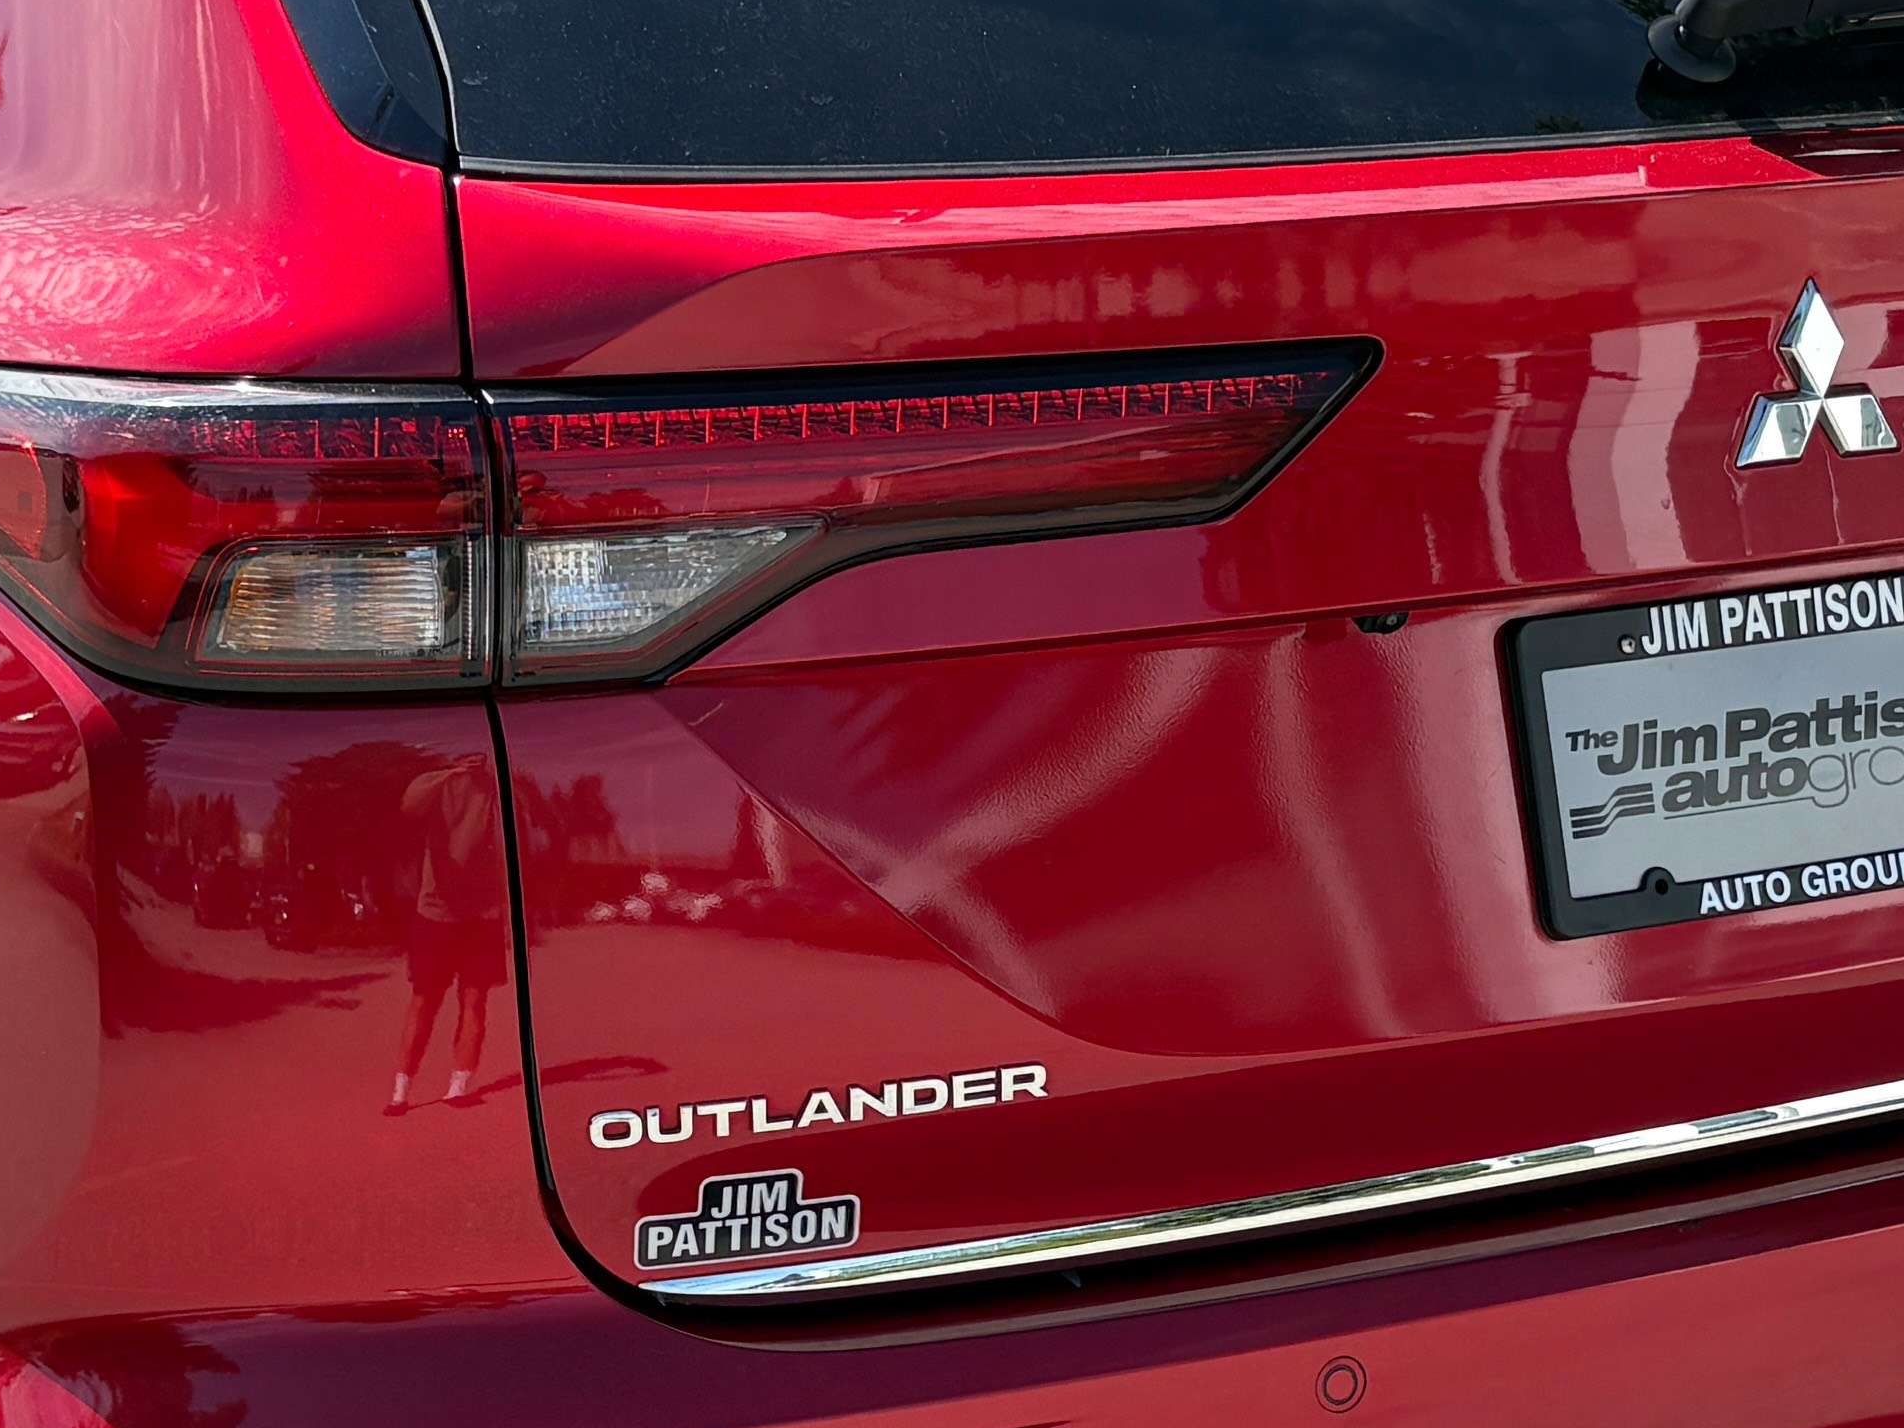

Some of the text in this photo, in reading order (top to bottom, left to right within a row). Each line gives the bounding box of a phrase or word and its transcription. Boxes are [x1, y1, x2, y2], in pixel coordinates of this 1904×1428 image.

[1641, 577, 1904, 657] JIM PATTISON
[1565, 726, 1619, 753] The
[1597, 718, 1718, 776] Jim
[1699, 869, 1792, 915] AUTO
[589, 1064, 1049, 1150] OUTLANDER
[711, 1180, 789, 1219] JIM
[646, 1205, 848, 1261] PATTISON
